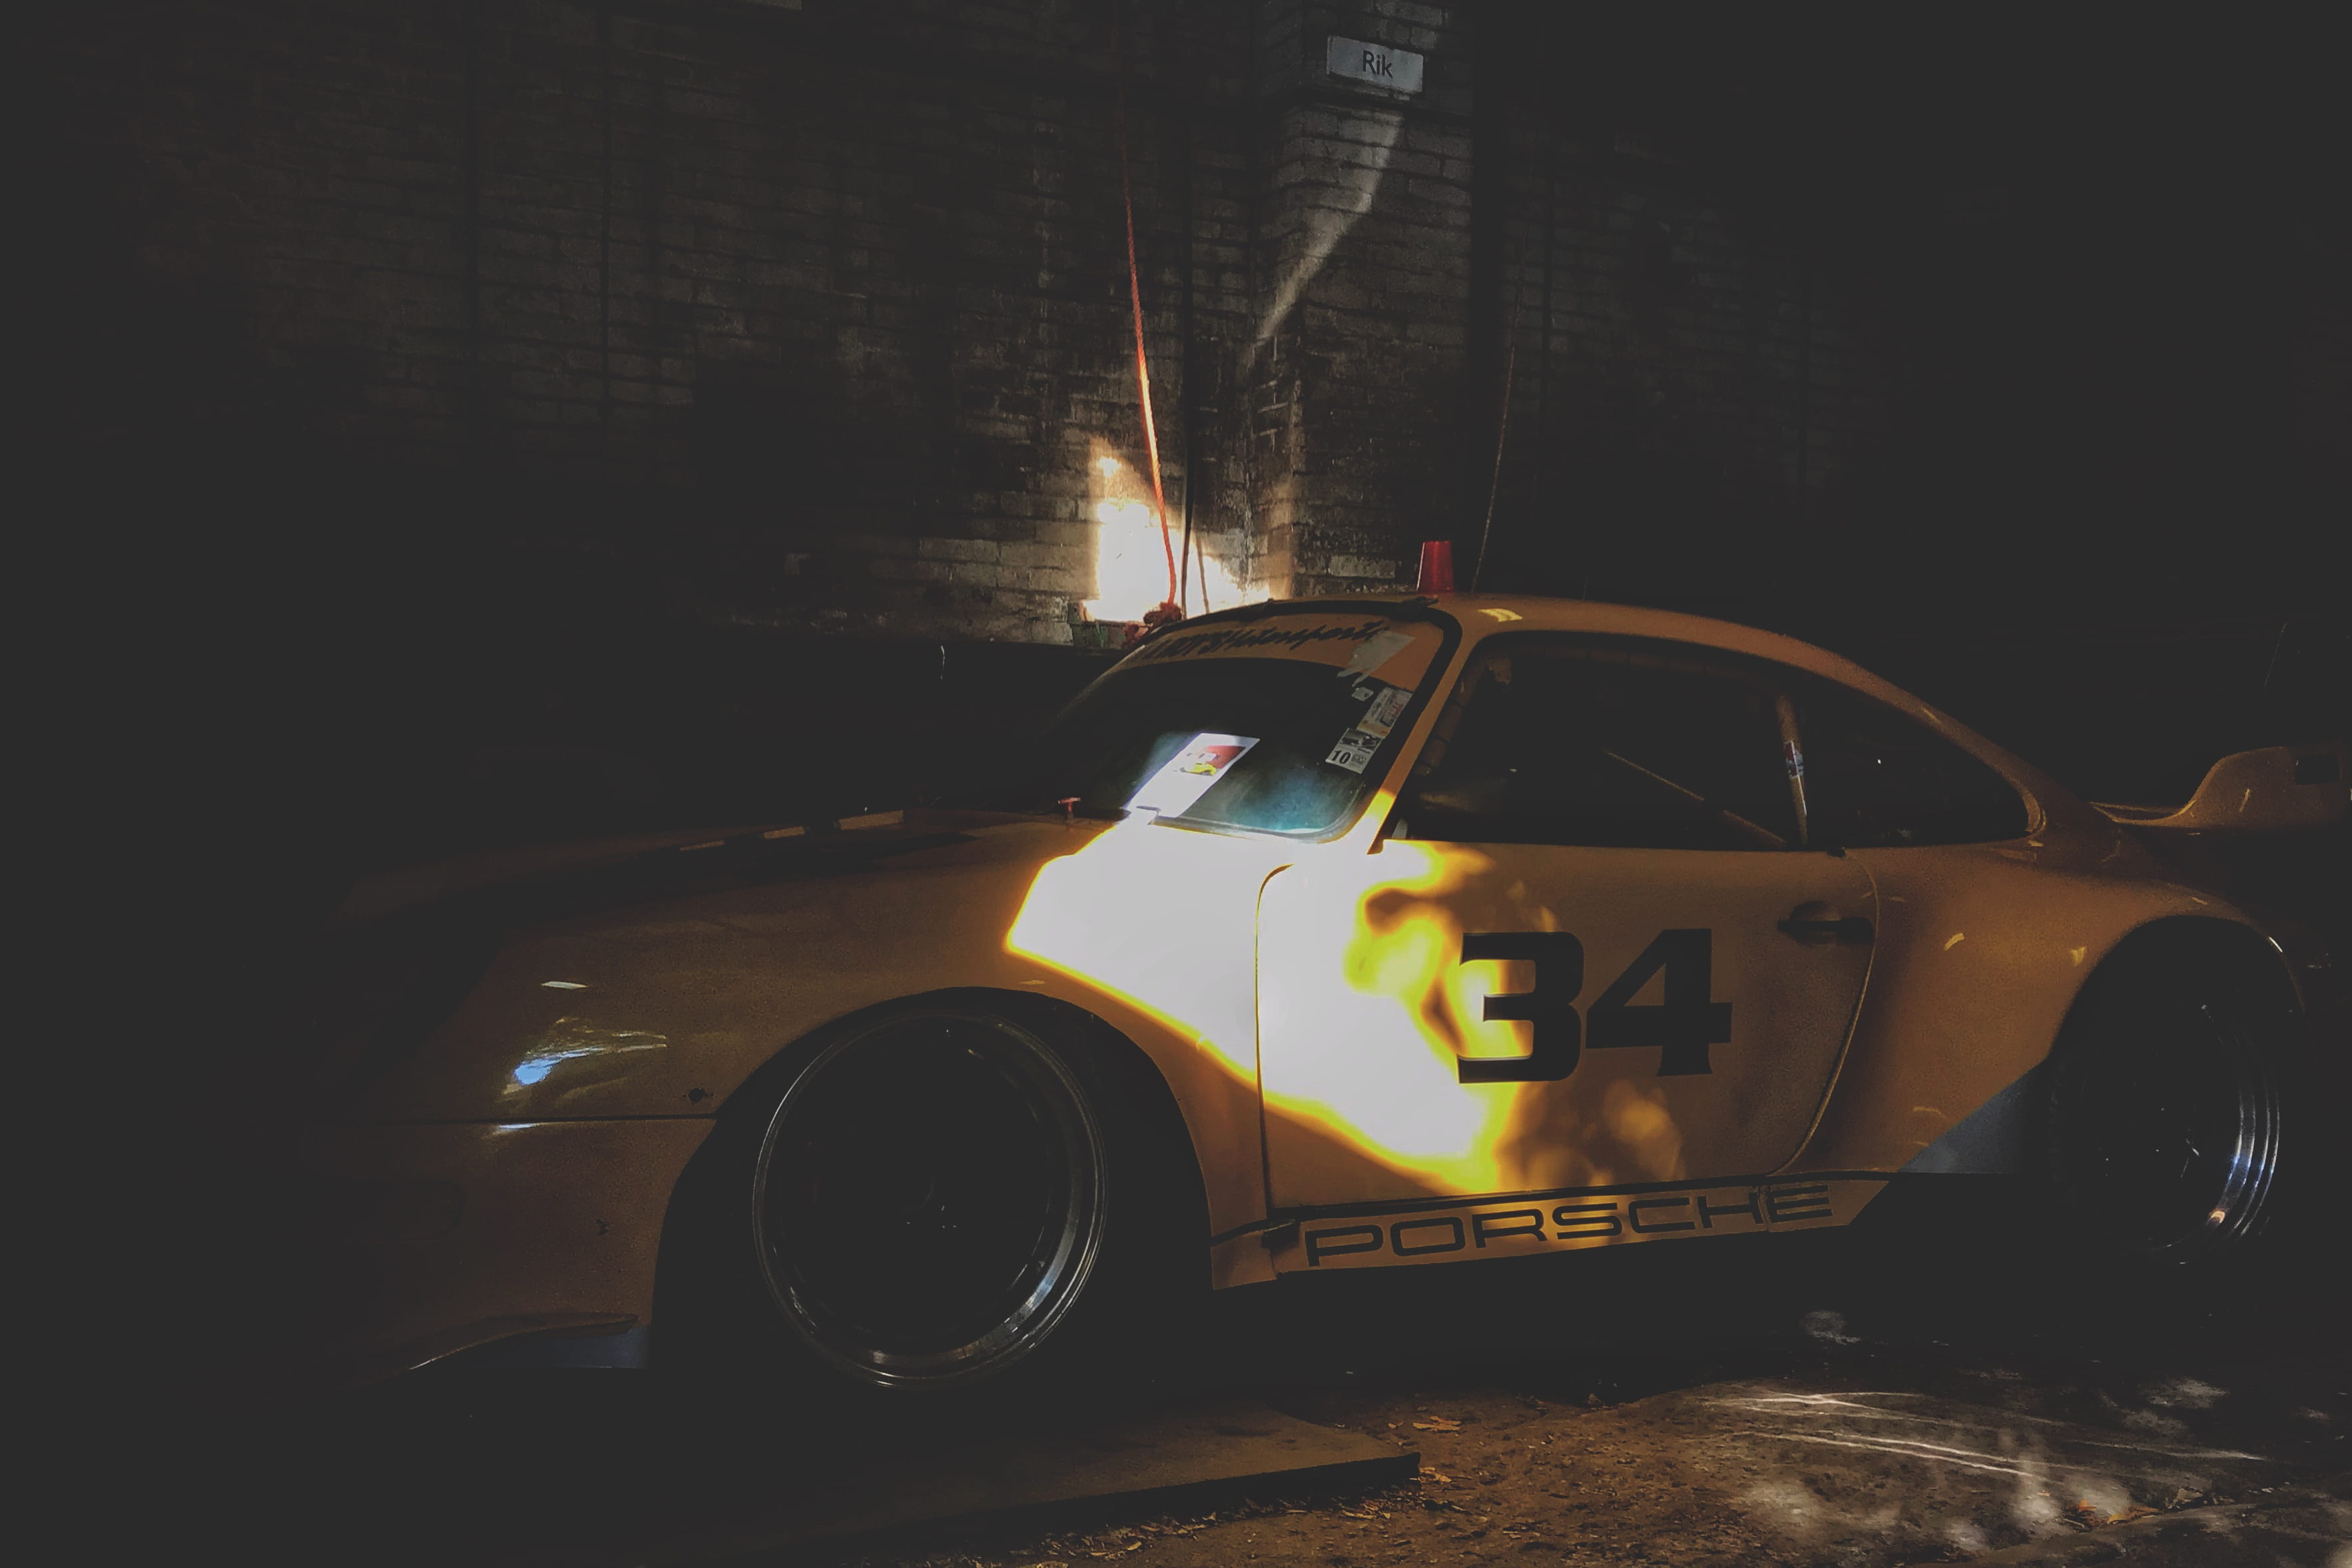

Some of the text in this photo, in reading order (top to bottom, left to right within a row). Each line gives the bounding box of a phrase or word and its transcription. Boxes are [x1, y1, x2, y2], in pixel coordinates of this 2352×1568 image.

[1362, 50, 1393, 79] Rik
[1332, 750, 1351, 764] 10
[1456, 928, 1732, 1084] 34
[1305, 1184, 1833, 1267] PORSCHE
